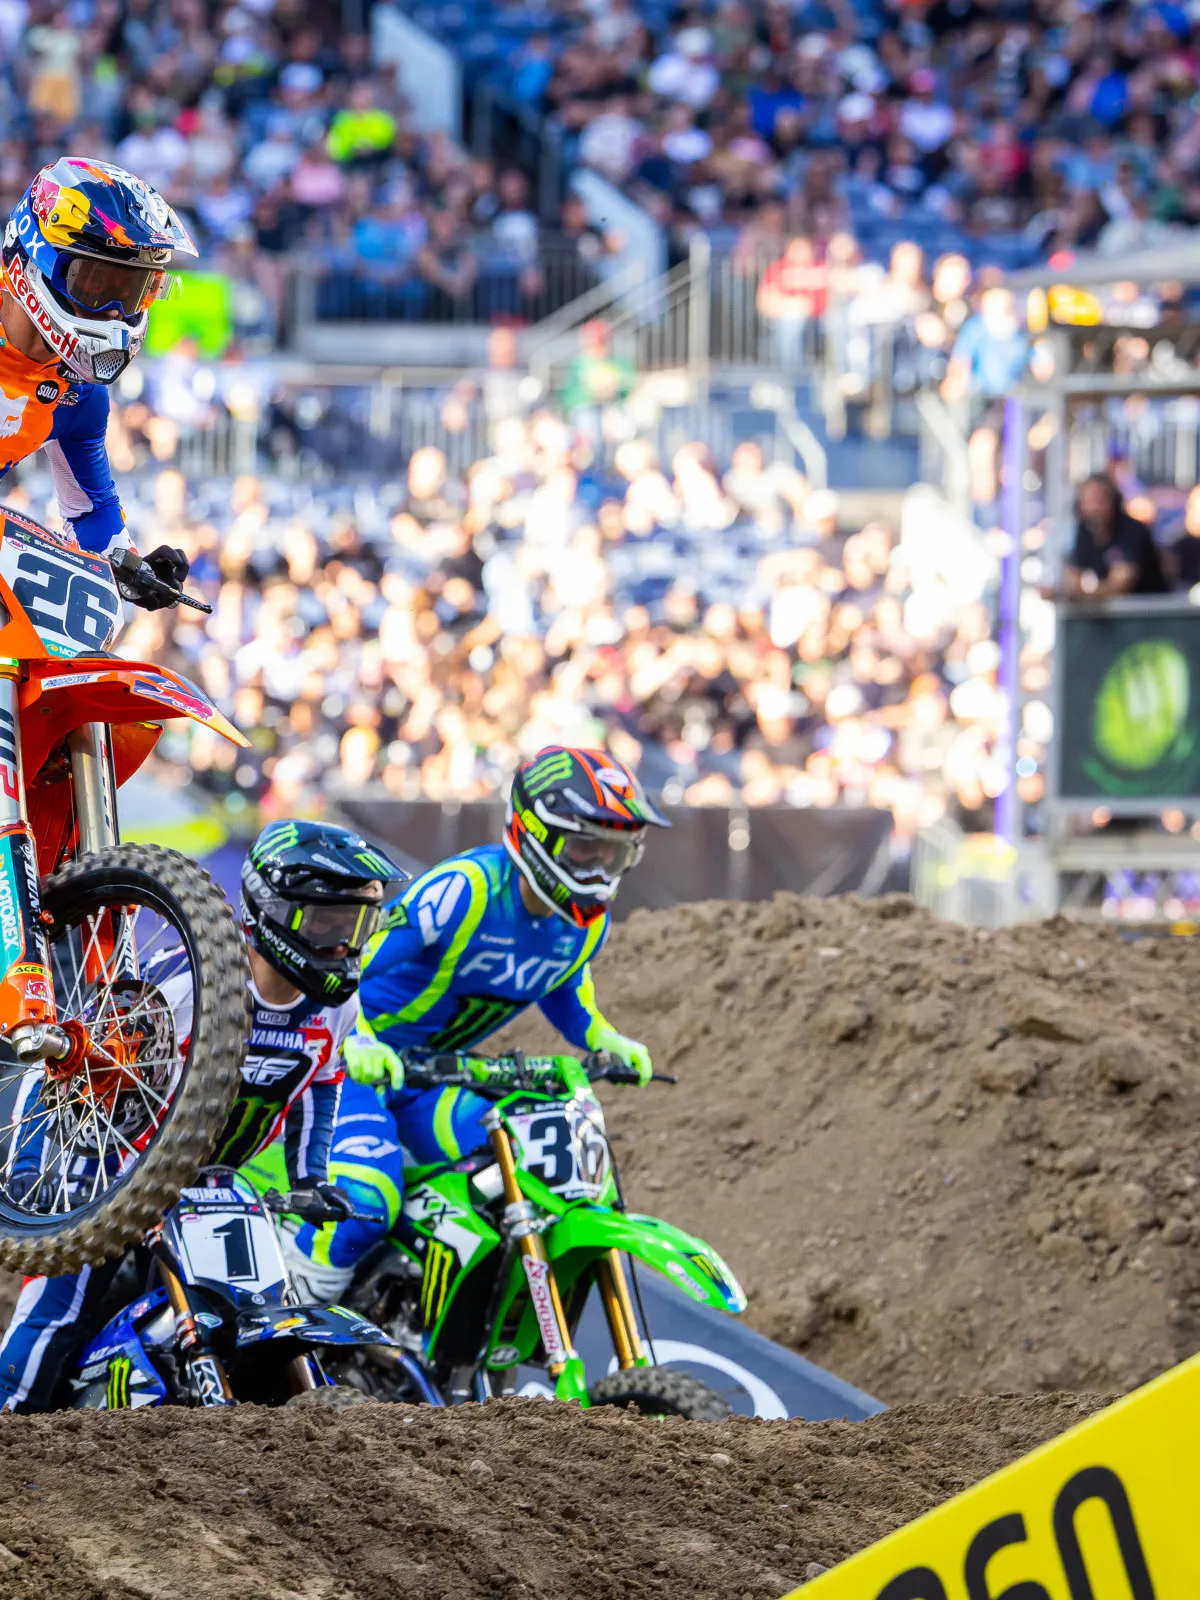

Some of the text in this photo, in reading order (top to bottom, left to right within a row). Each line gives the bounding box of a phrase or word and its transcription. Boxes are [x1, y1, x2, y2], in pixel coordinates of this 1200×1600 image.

[17, 198, 45, 260] FOX
[8, 253, 40, 317] Red
[37, 313, 80, 360] Bull
[37, 385, 58, 400] SOLO
[34, 539, 85, 565] SUPERCROSS
[12, 552, 119, 651] 26
[458, 950, 572, 990] FXR
[251, 1029, 303, 1049] YAMAHA
[407, 1186, 459, 1224] KX
[212, 1217, 260, 1282] 1
